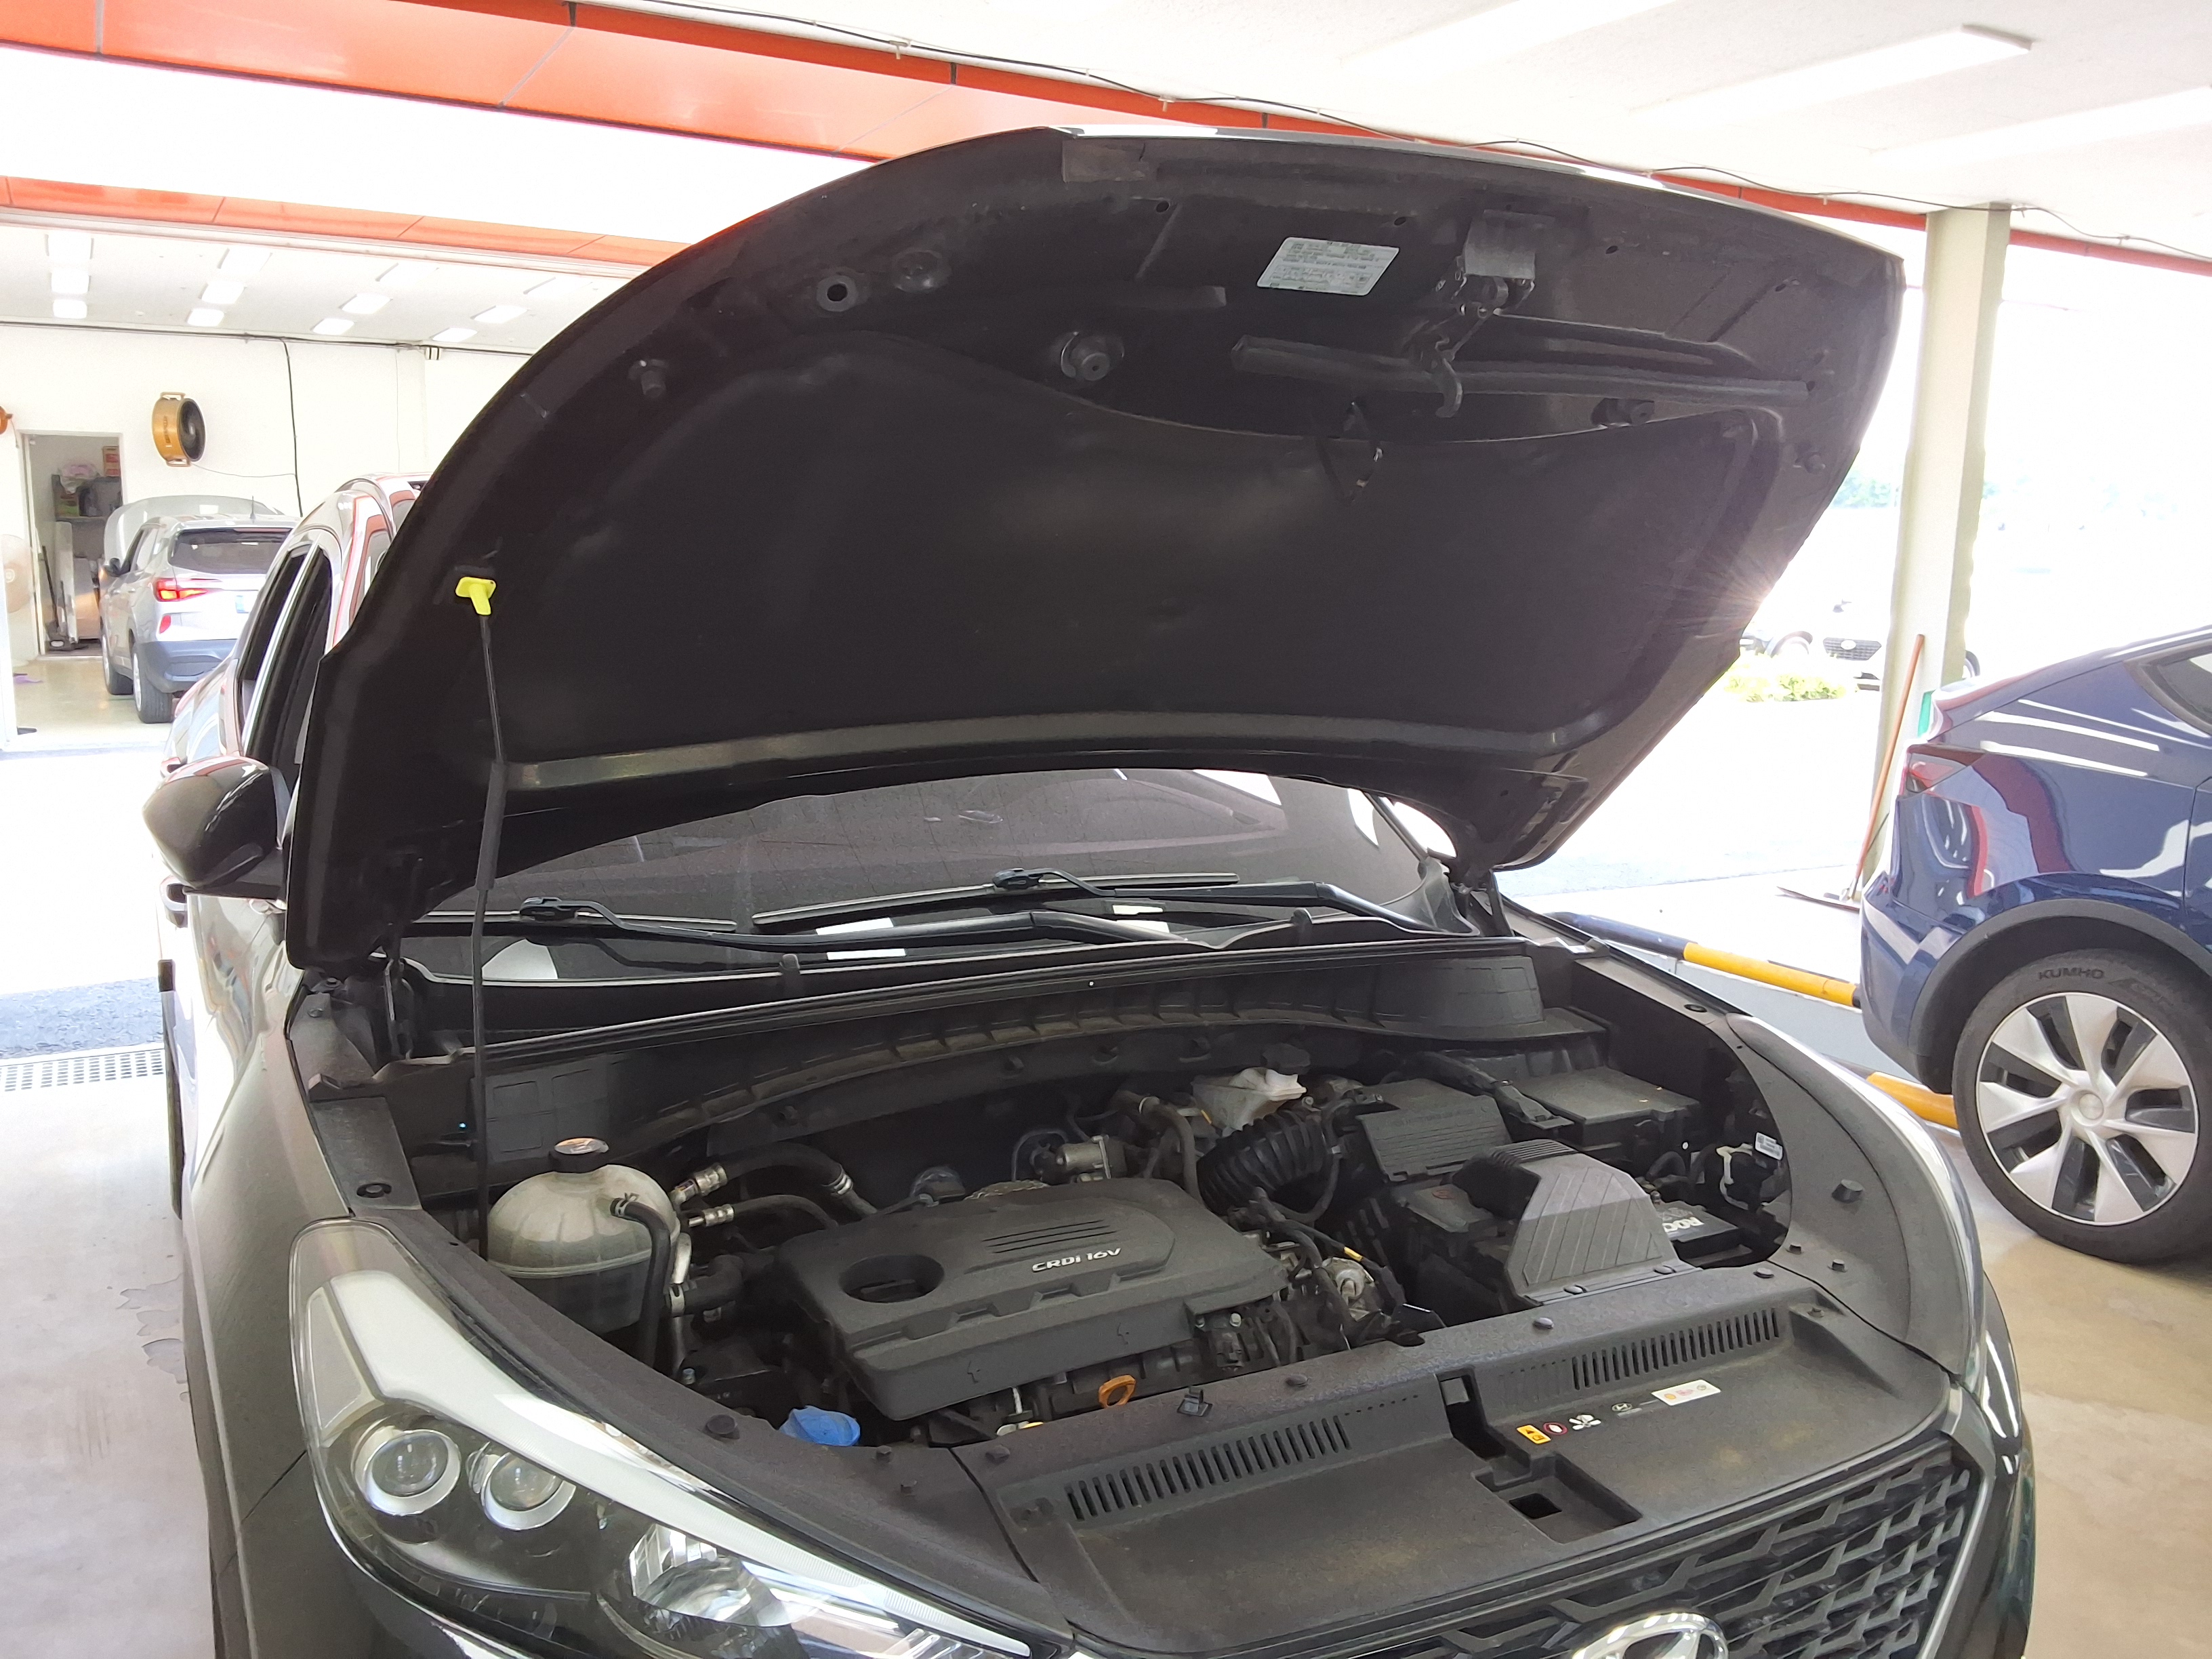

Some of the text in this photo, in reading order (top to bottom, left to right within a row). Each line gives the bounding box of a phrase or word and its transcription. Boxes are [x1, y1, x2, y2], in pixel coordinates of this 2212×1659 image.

[2038, 966, 2104, 980] KUMHO
[1031, 1248, 1122, 1273] CRDi 16V
